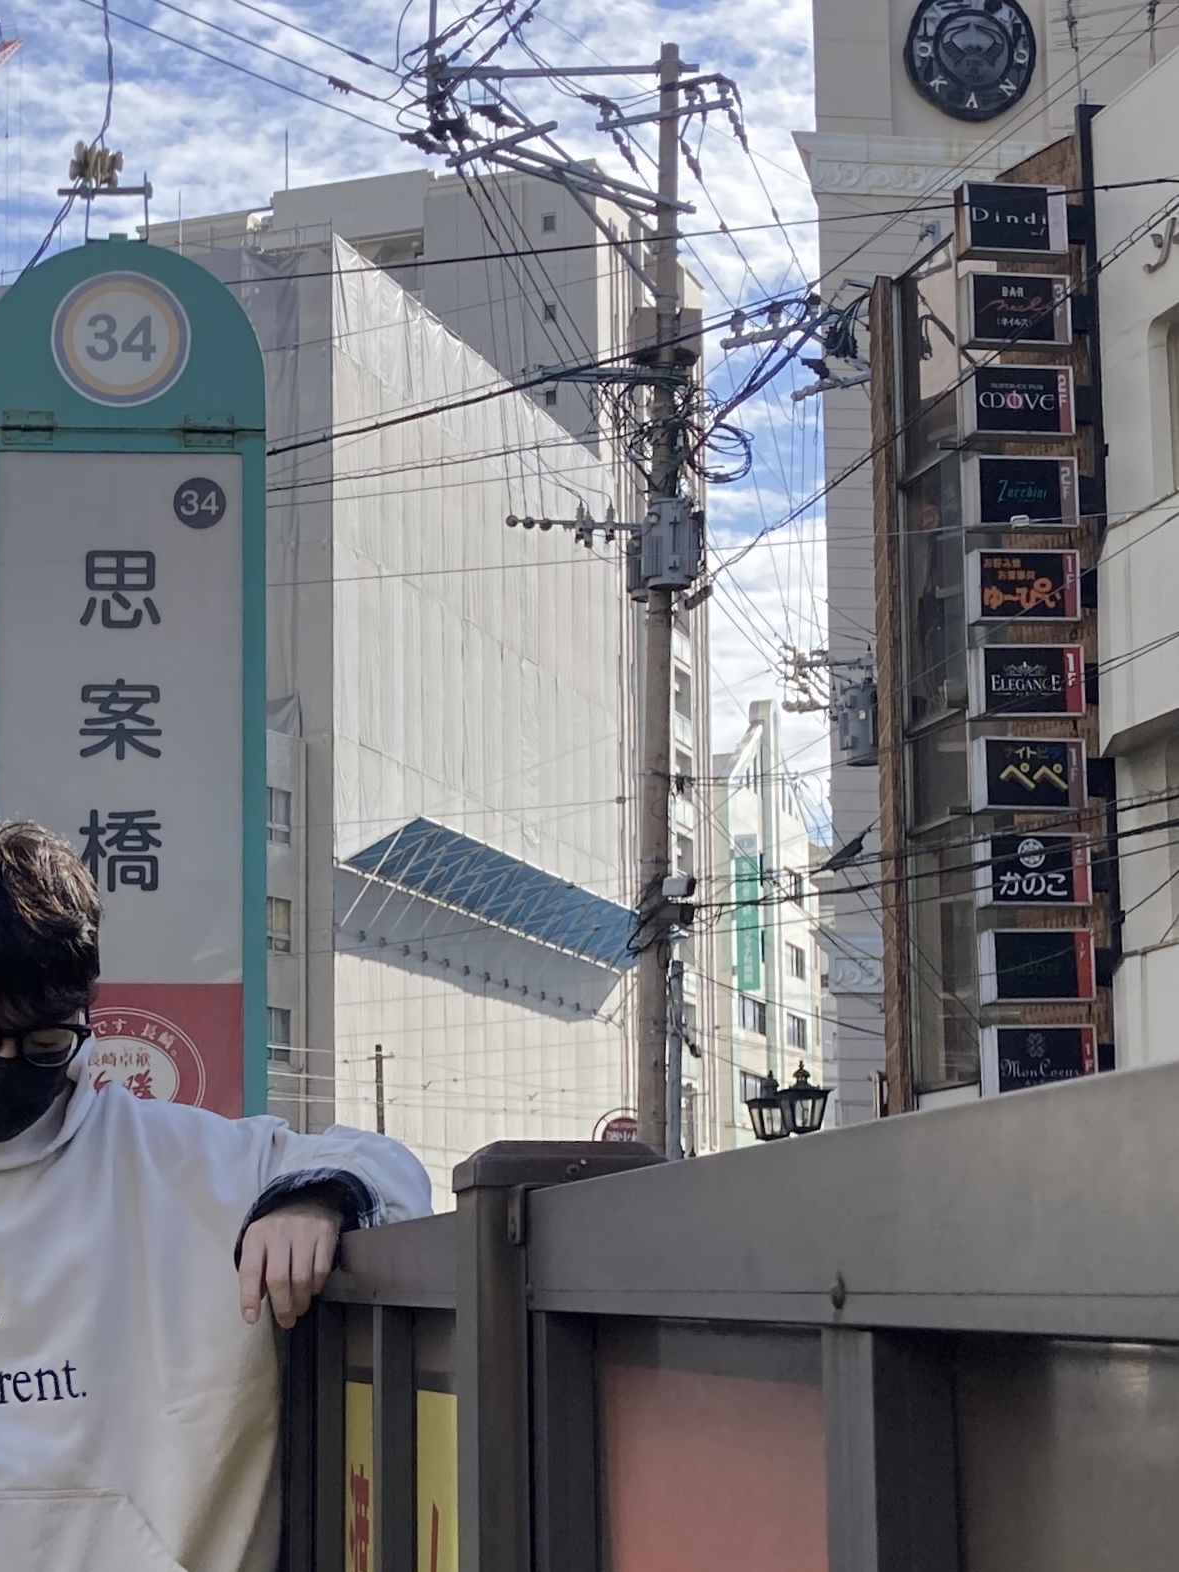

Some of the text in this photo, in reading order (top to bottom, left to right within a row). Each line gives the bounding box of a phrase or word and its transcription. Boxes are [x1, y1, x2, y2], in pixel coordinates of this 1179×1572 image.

[972, 206, 1047, 226] Dindi
[1002, 286, 1024, 297] BAR
[85, 313, 157, 363] 34
[1057, 374, 1068, 408] 2F
[1060, 466, 1071, 500] 2F
[180, 489, 219, 516] 34
[991, 674, 1061, 692] ELEGANCE
[1066, 653, 1076, 687] 1F
[78, 549, 163, 894] 思案橋
[1069, 748, 1078, 782] 1F
[999, 871, 1068, 897] かのこ
[1085, 1043, 1094, 1073] 1F
